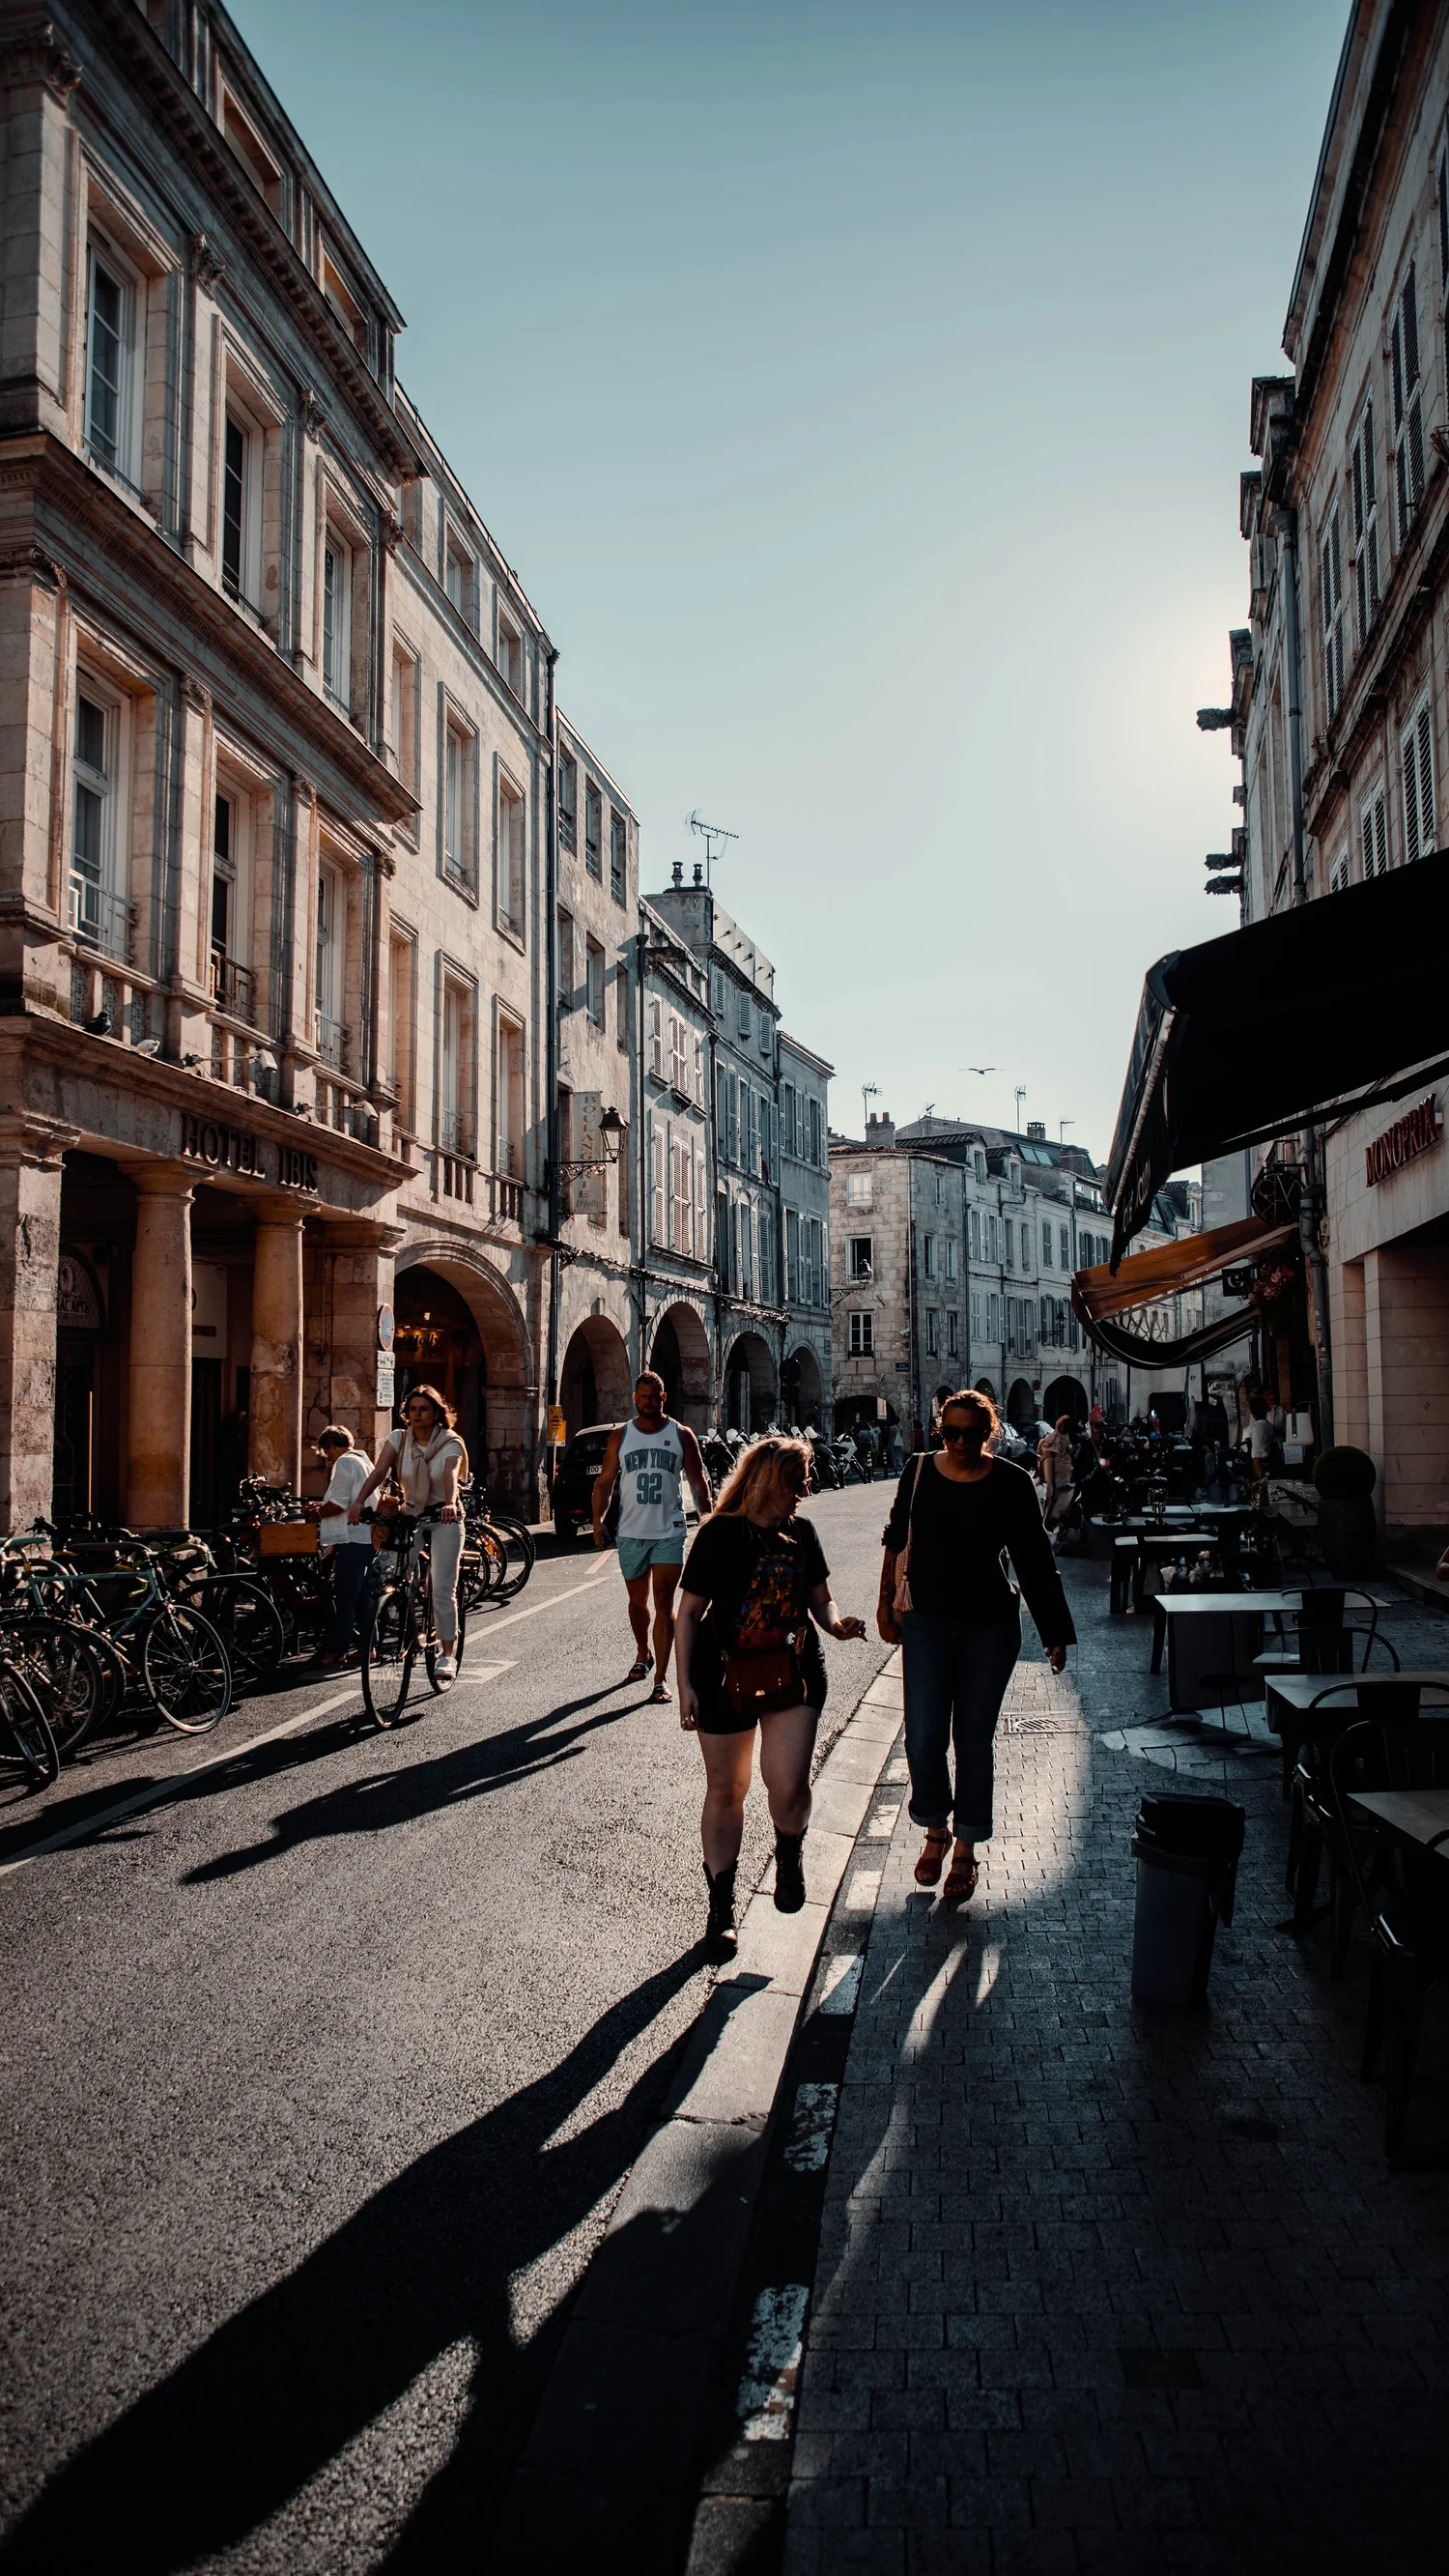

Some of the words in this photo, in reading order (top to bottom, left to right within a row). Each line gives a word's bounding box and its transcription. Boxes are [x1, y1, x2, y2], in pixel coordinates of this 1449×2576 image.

[1365, 1093, 1439, 1188] MONOPRIX
[279, 1147, 318, 1193] IBIS
[624, 1448, 650, 1474] NEW
[650, 1448, 678, 1474] YORK
[637, 1473, 663, 1504] 92
